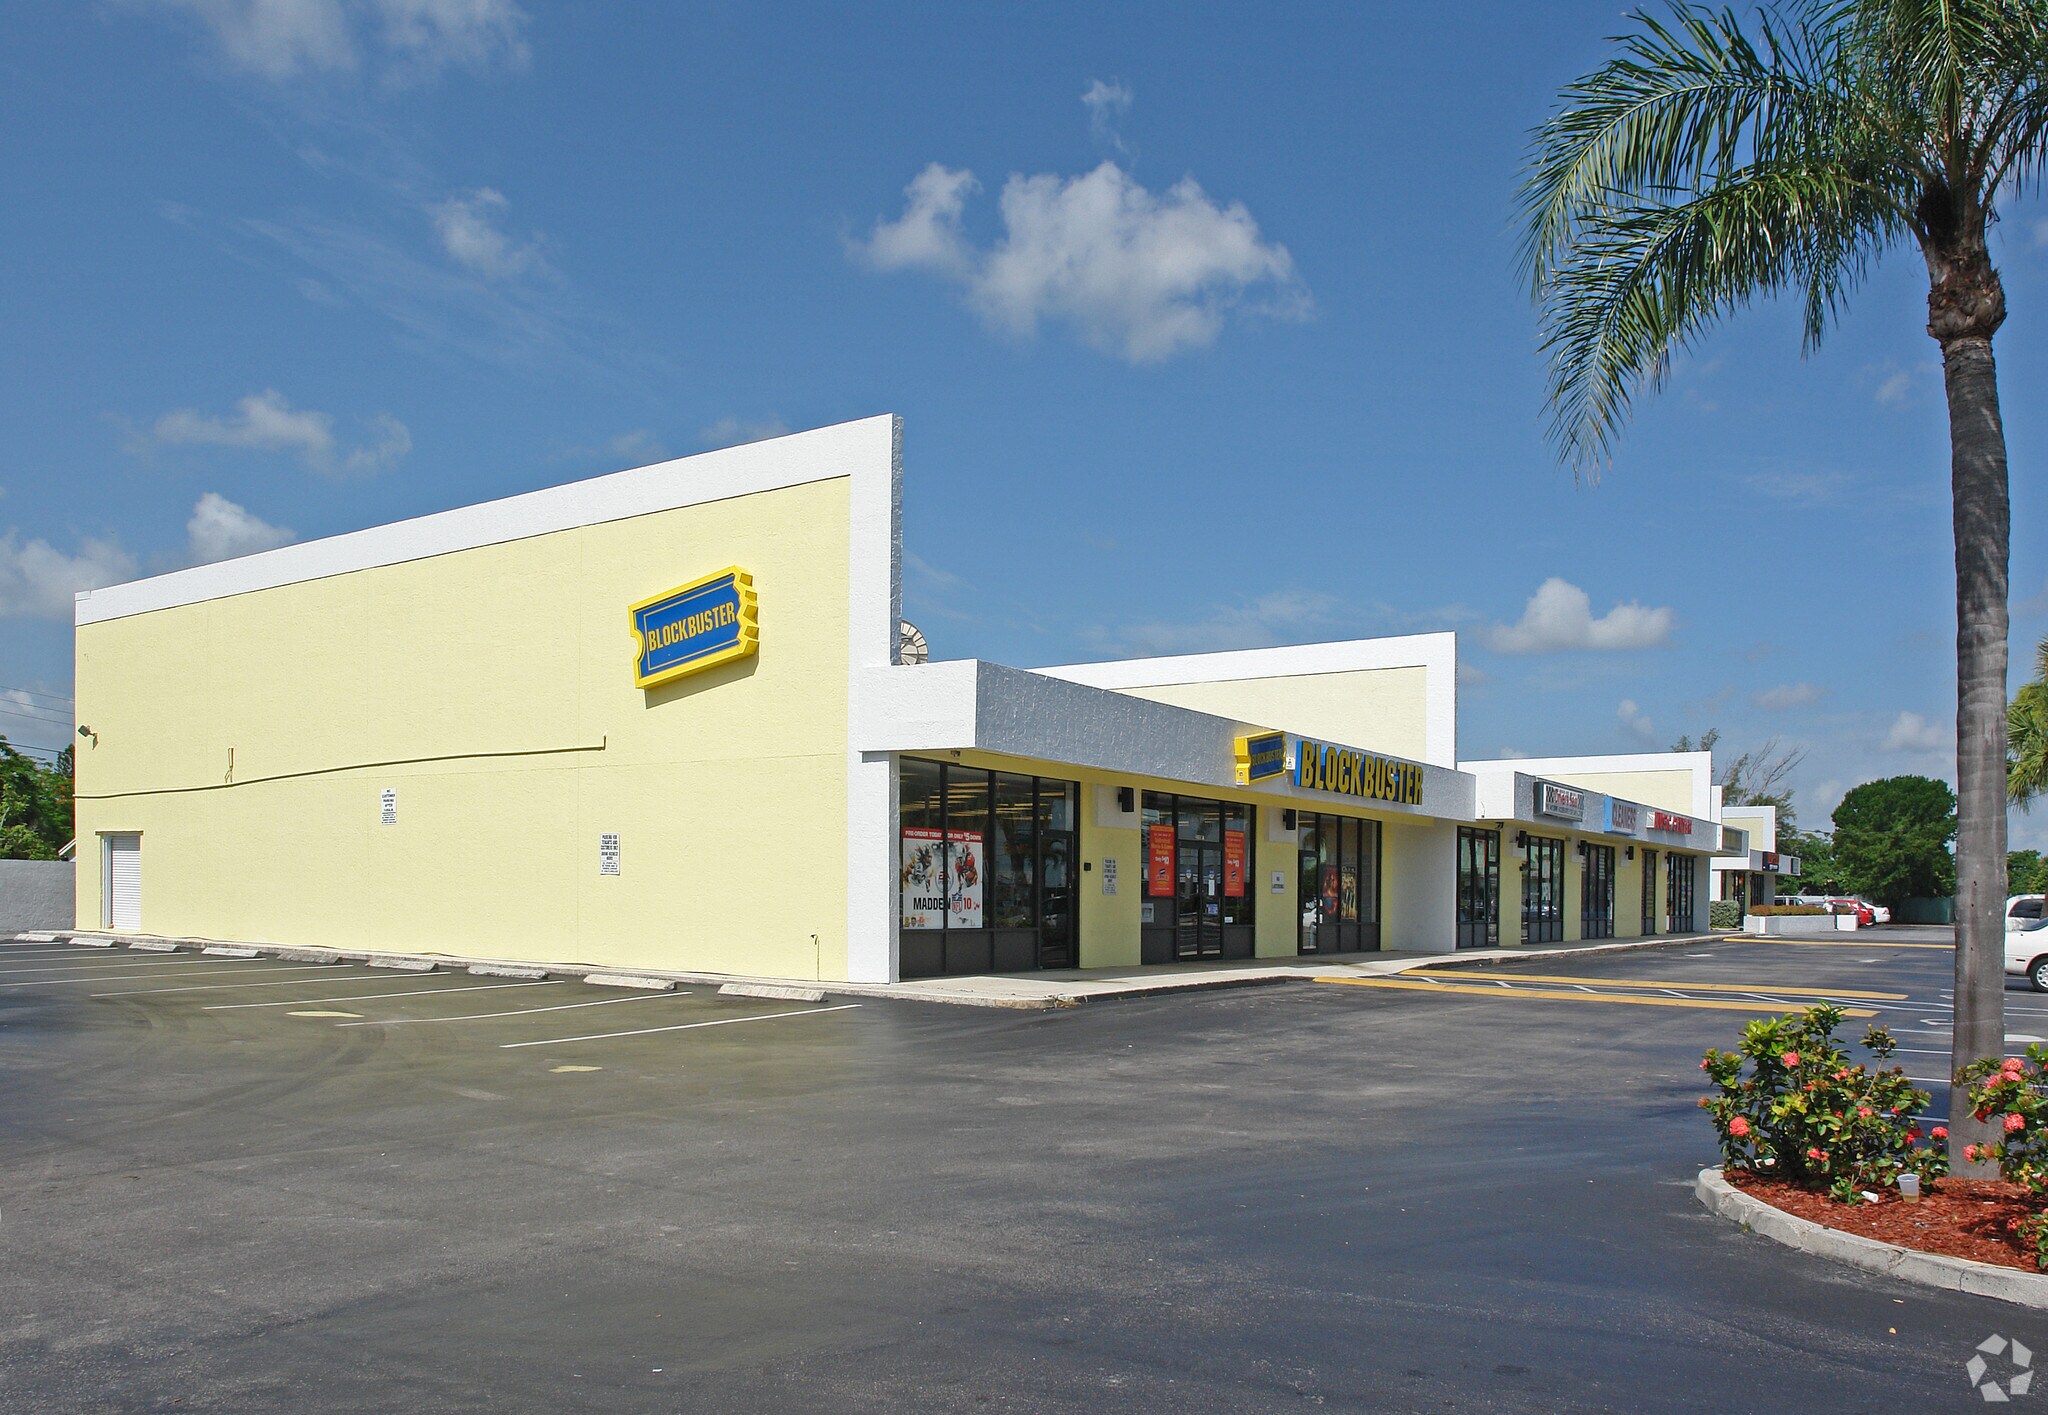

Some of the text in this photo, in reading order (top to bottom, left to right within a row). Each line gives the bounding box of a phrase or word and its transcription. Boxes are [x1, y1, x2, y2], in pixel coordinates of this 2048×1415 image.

[648, 601, 736, 652] BLOCKBUSTER
[1252, 748, 1283, 766] BLOCKBUSTER
[1299, 741, 1423, 805] BLOCKBUSTER
[1612, 803, 1636, 830] CLEANERS
[963, 897, 972, 910] 10
